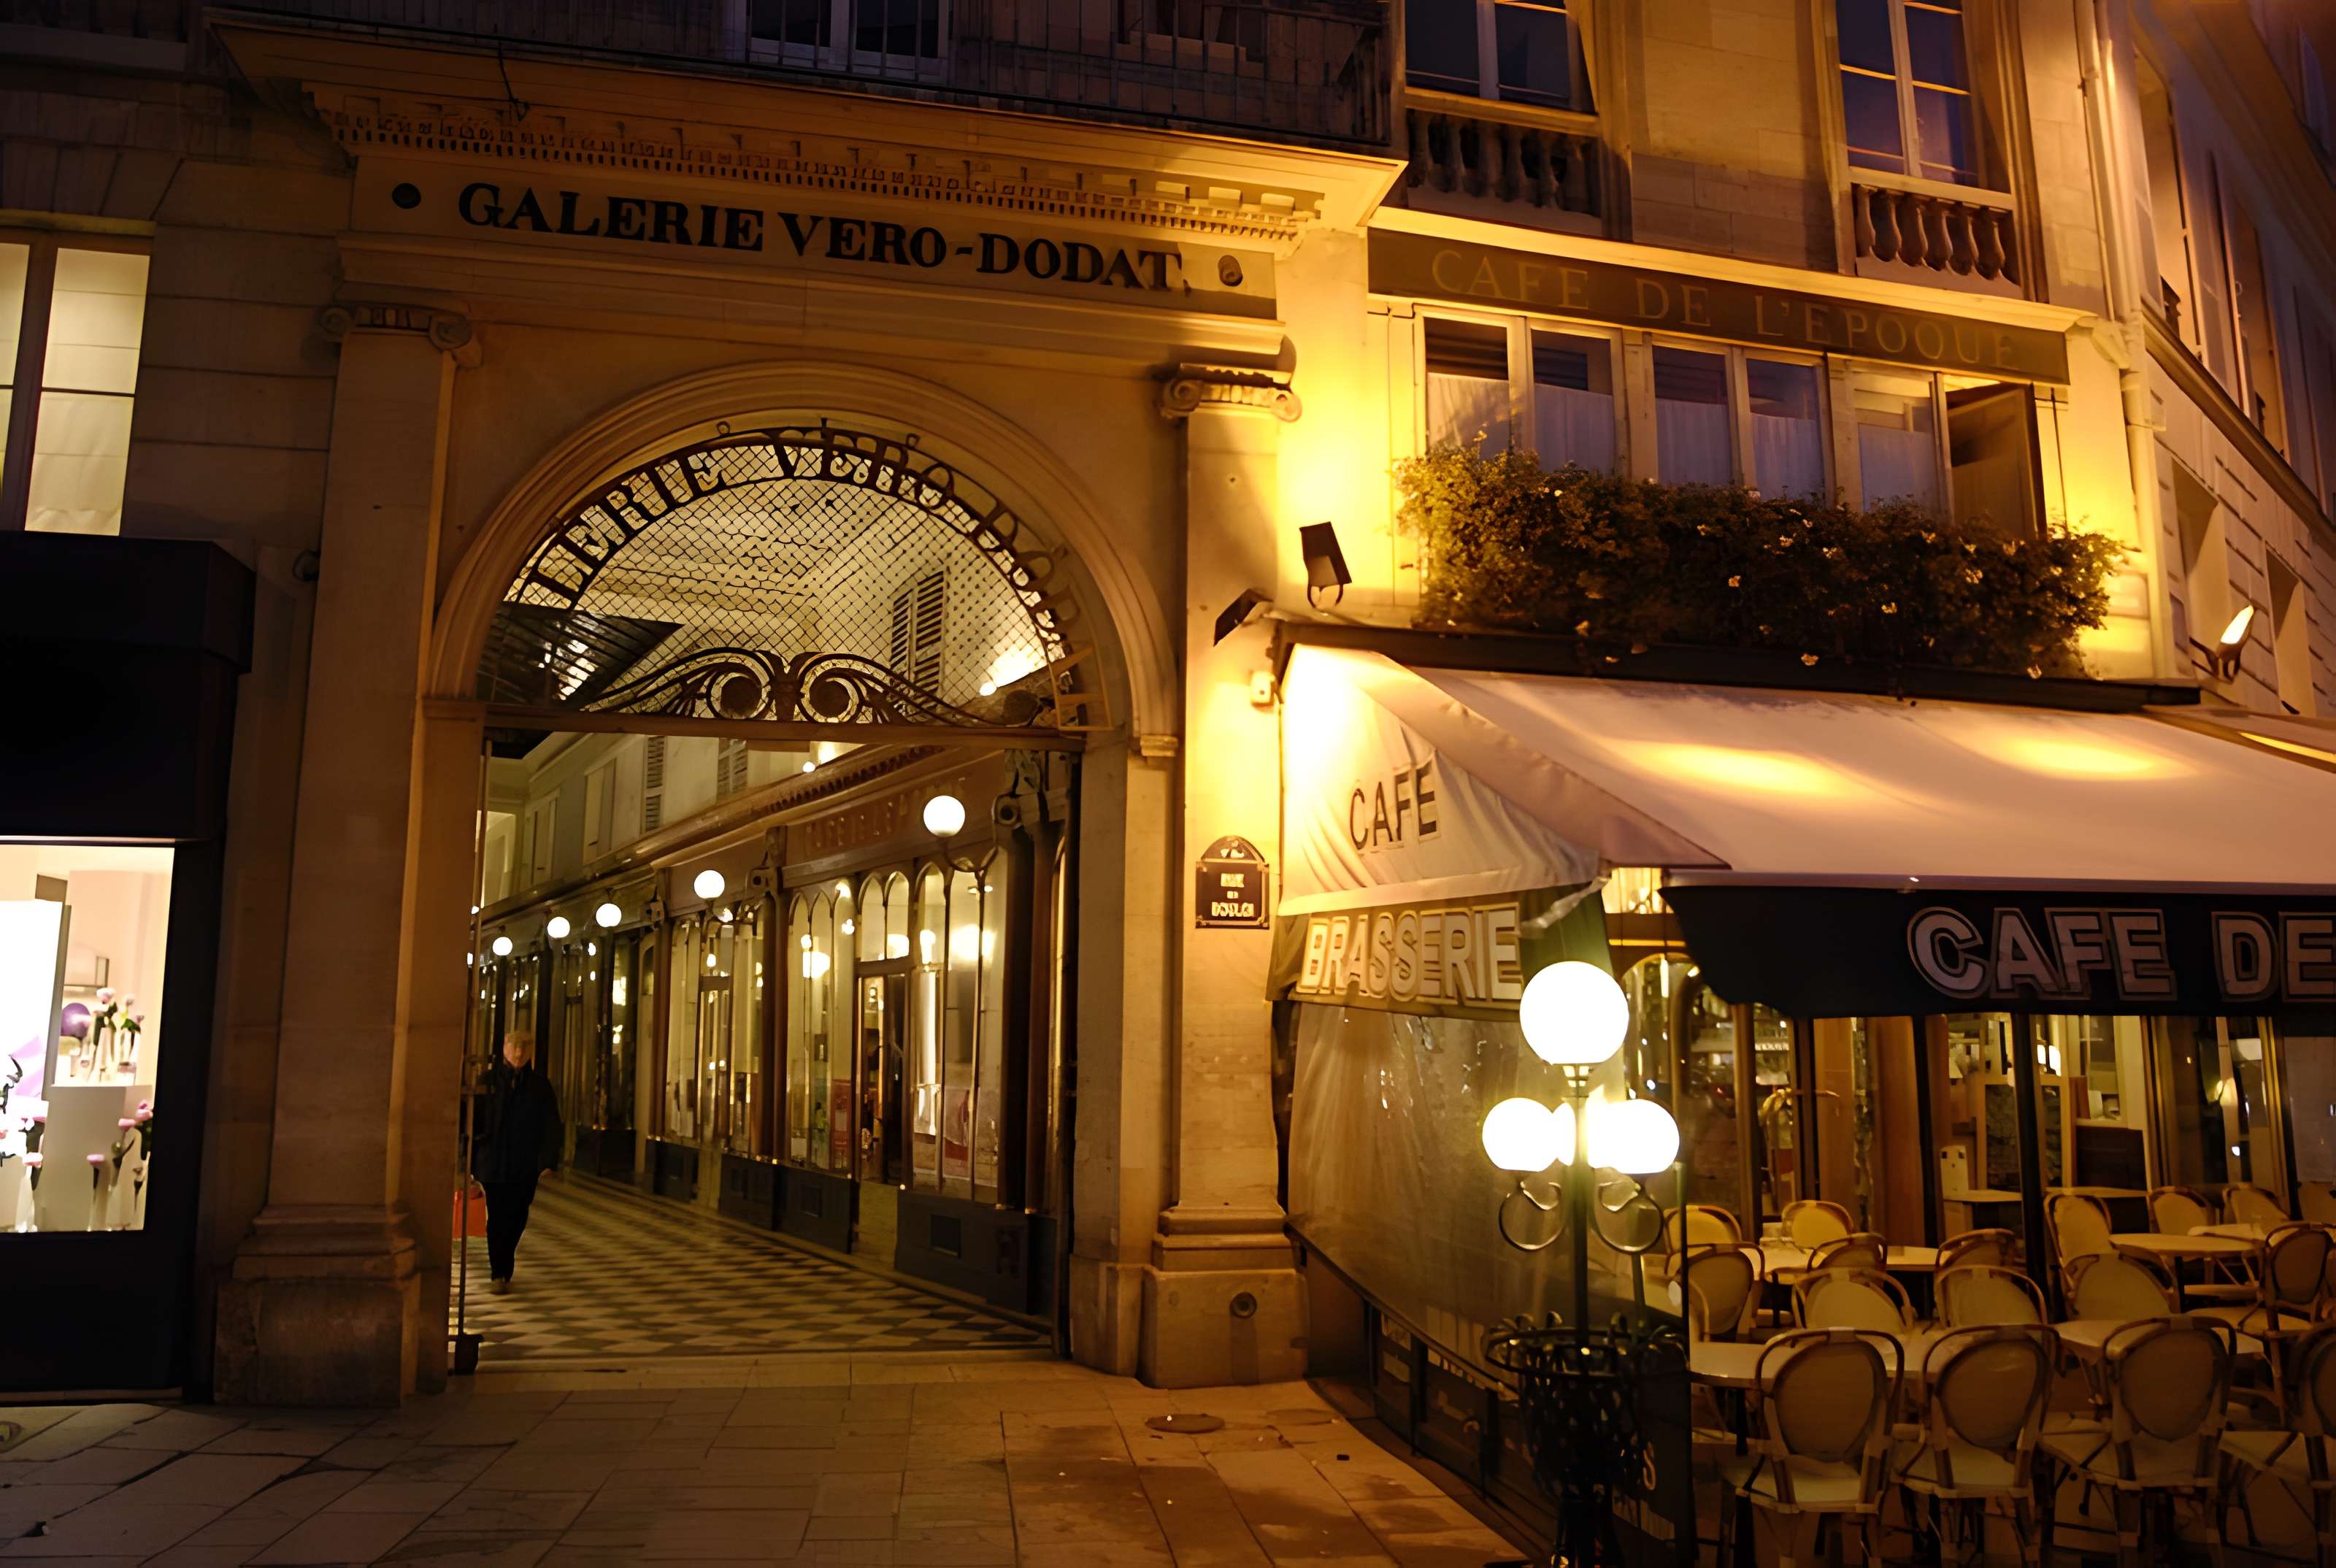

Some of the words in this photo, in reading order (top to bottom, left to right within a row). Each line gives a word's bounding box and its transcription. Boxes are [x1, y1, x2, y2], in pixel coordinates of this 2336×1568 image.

[458, 182, 764, 251] GALERIE
[1432, 249, 1590, 310] CAFE
[1634, 276, 1711, 327] DE
[1350, 761, 1438, 850] CAFE
[1296, 902, 1524, 1004] BRASSERIE
[1905, 905, 2178, 1004] CAFE
[2210, 910, 2336, 1004] DE
